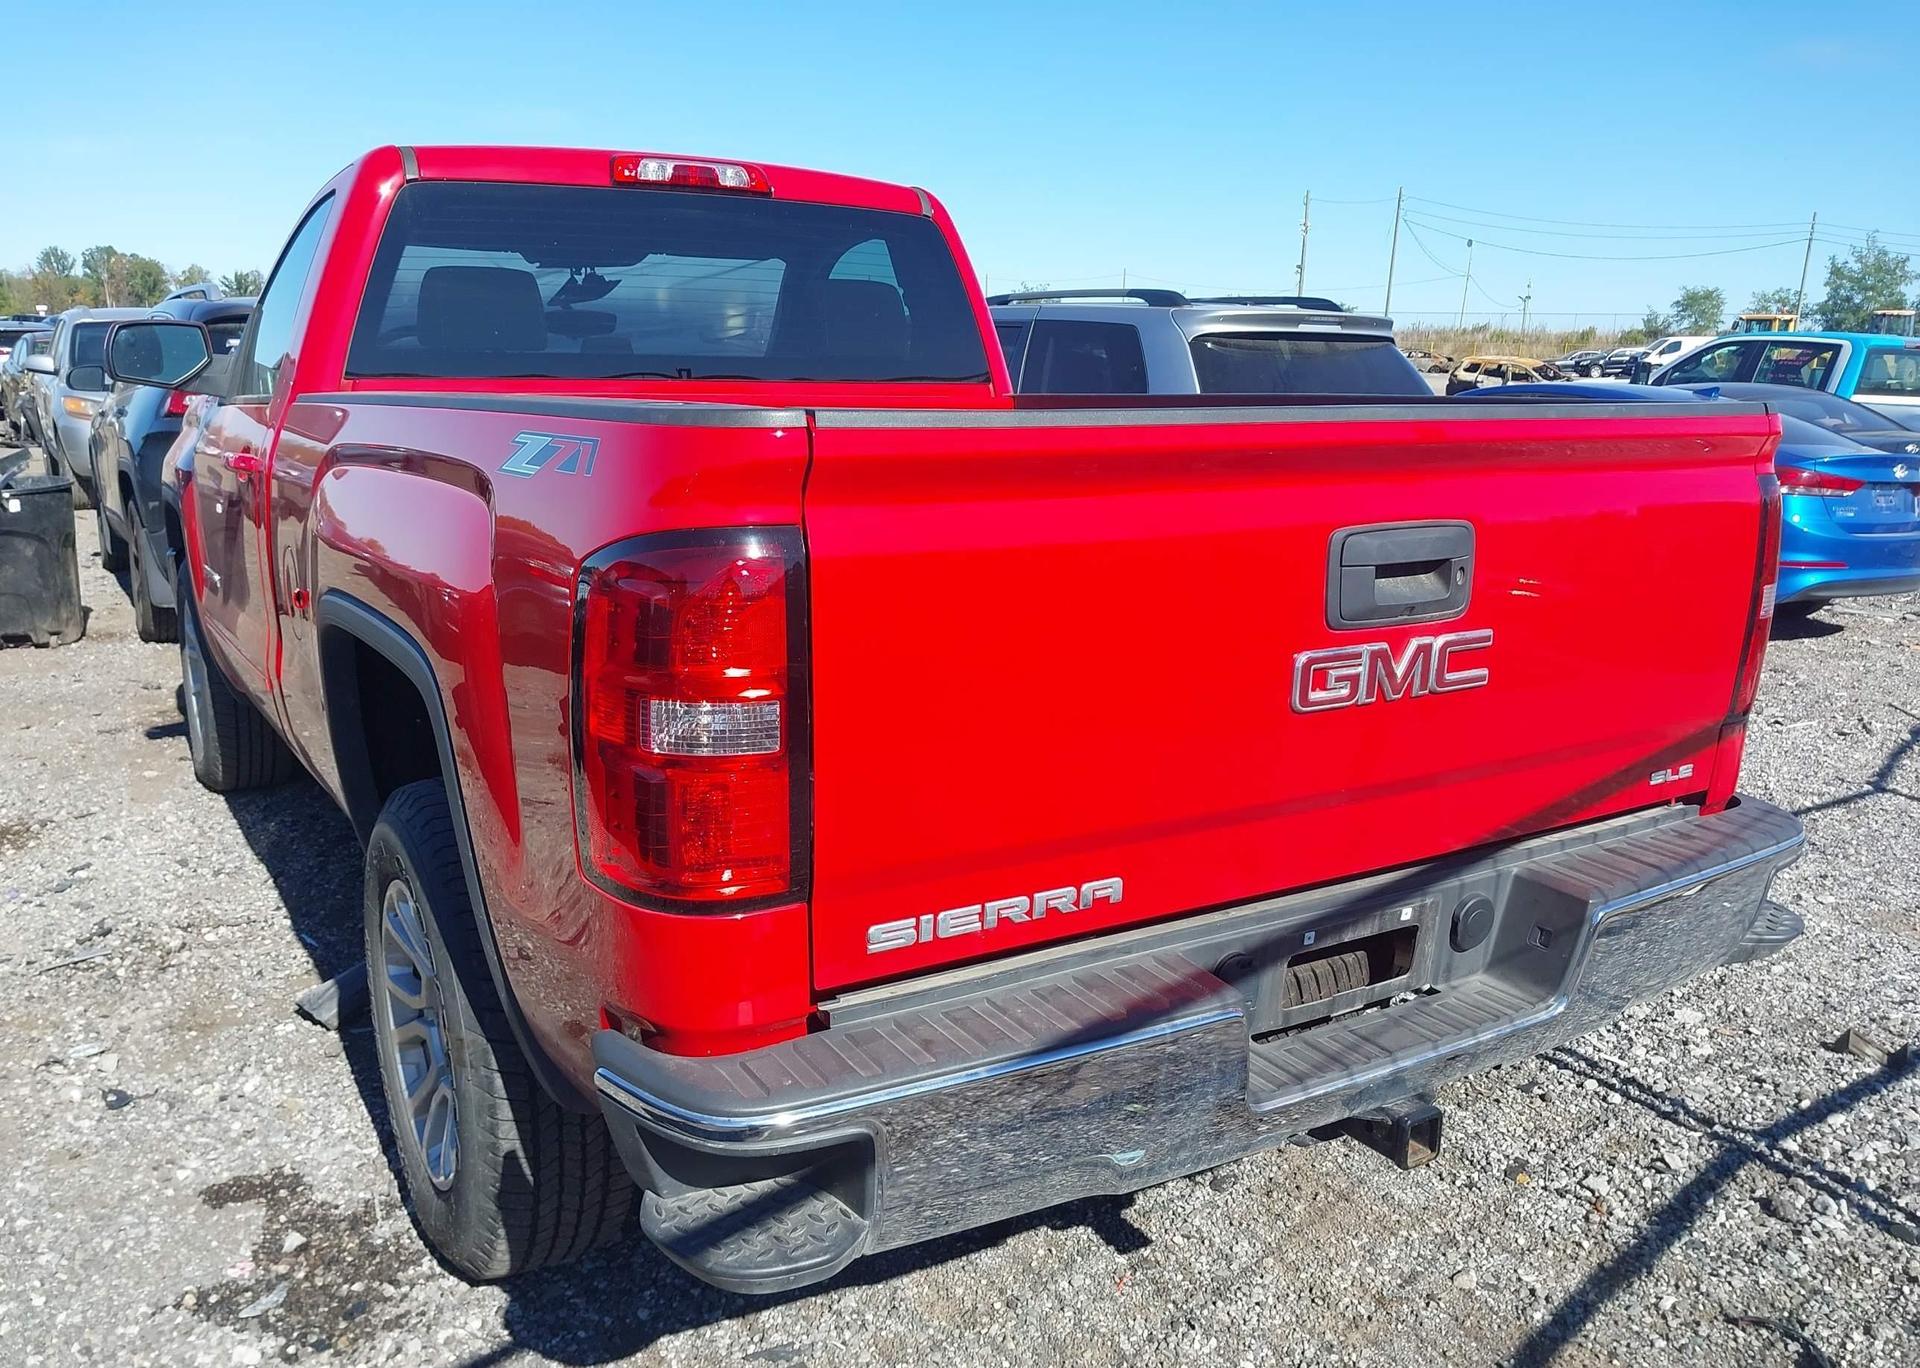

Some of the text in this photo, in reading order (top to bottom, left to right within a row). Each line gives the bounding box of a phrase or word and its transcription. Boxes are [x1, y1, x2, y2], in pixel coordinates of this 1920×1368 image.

[496, 429, 601, 479] Z71
[1291, 628, 1494, 713] GMC
[1649, 763, 1694, 786] SLE
[867, 876, 1123, 954] SIERRA
